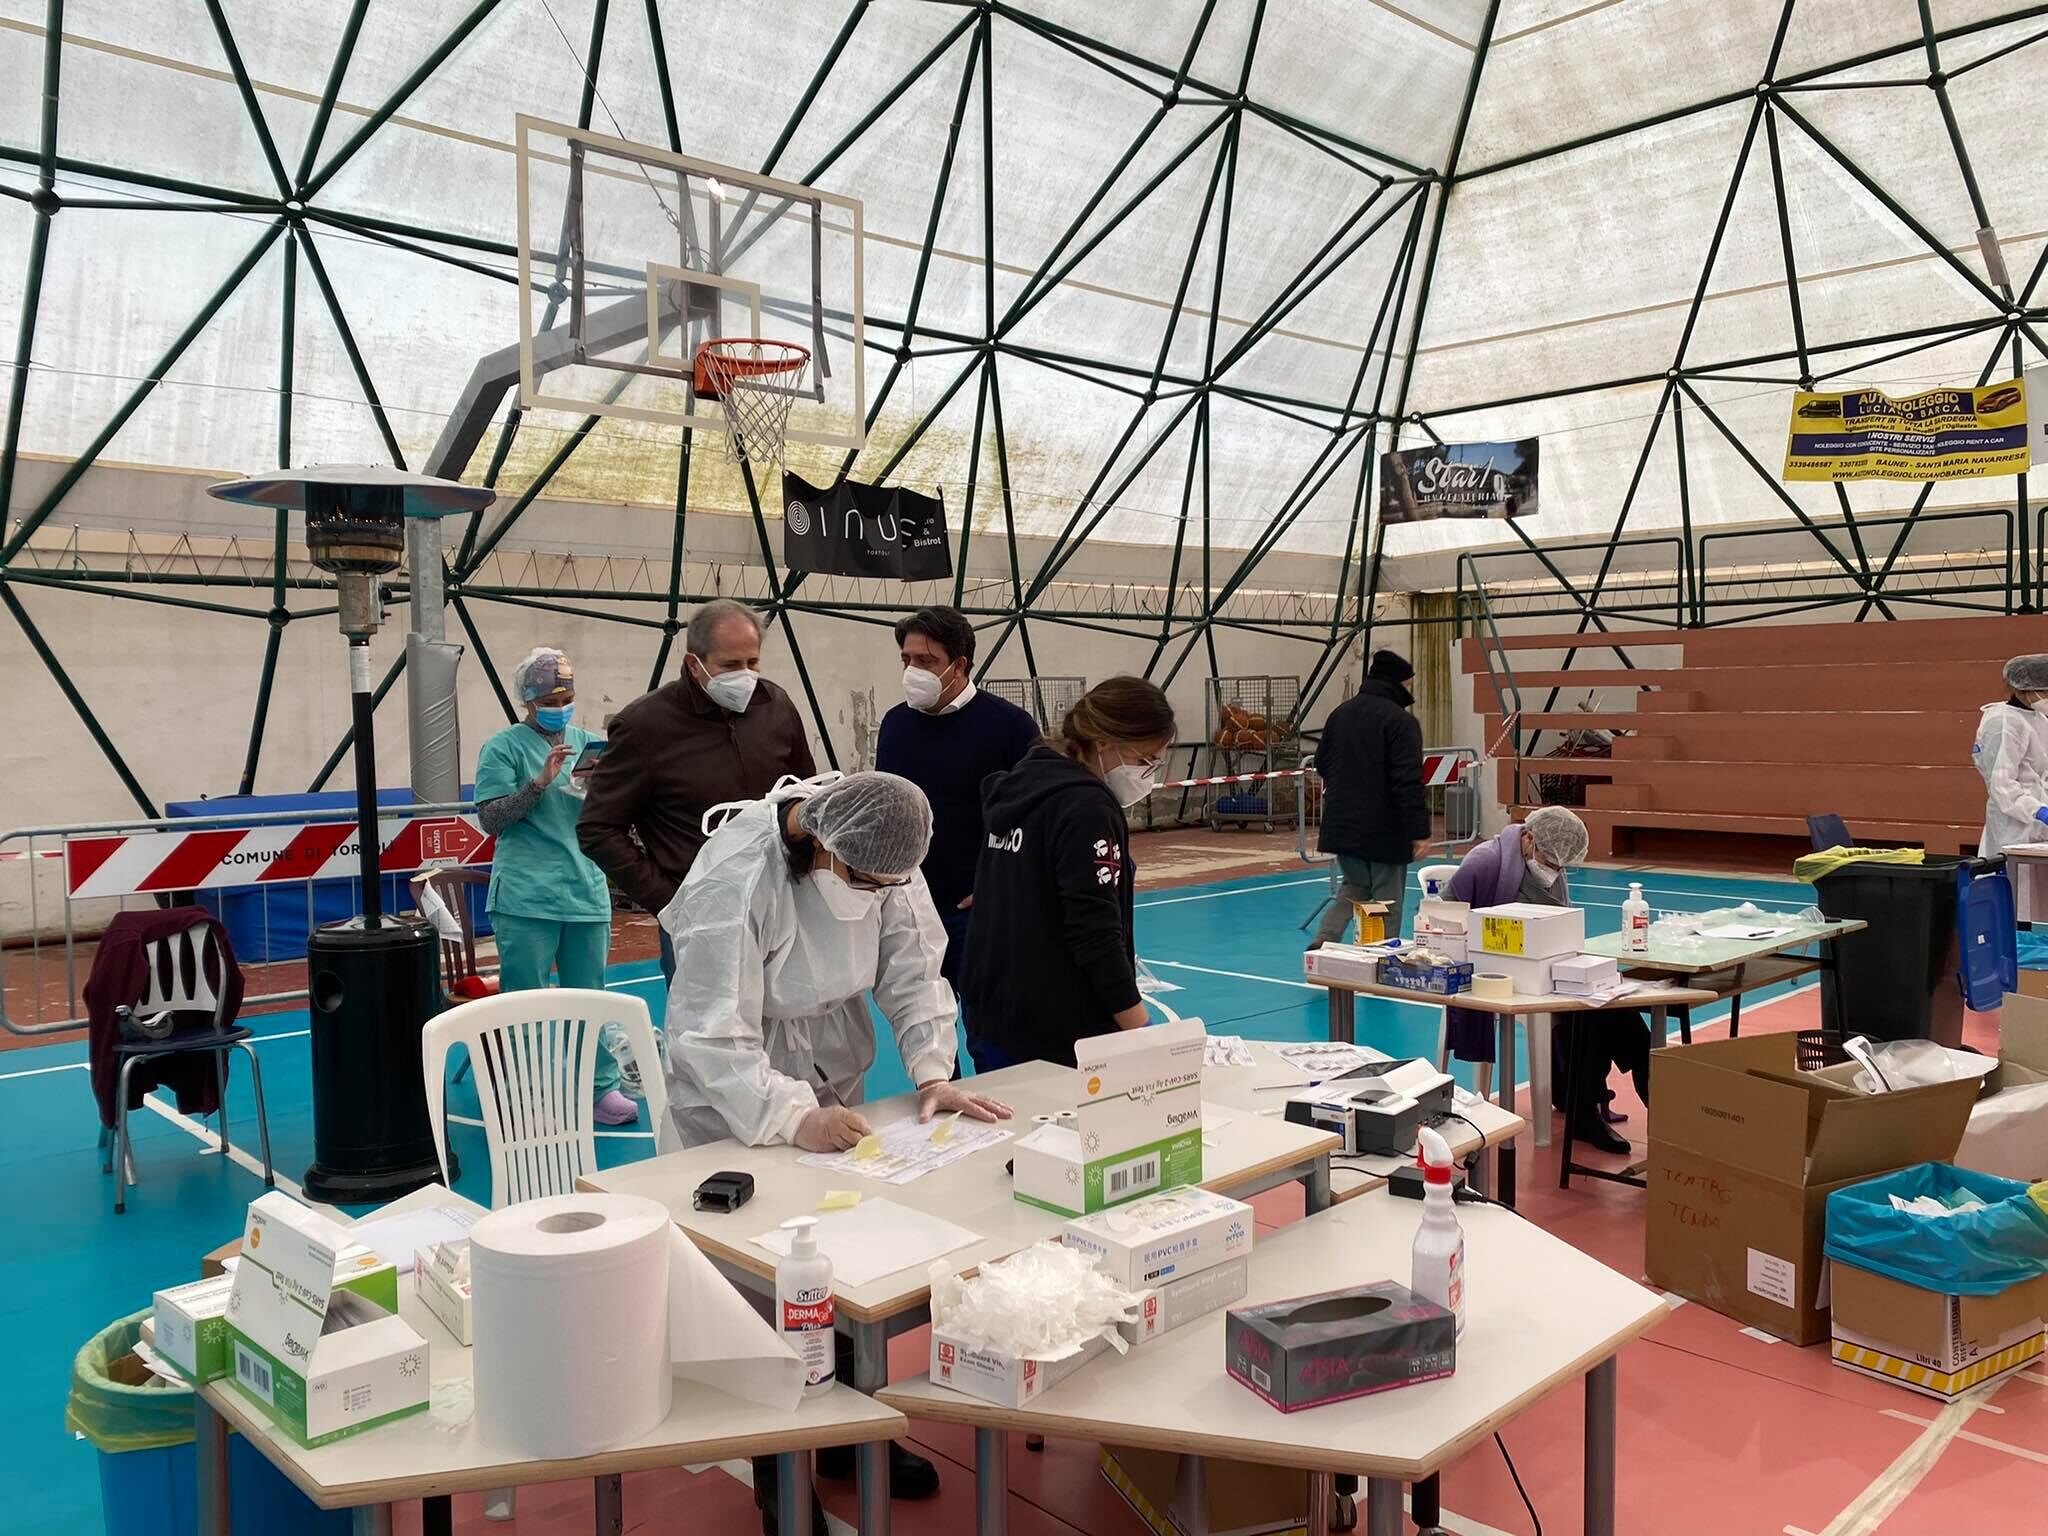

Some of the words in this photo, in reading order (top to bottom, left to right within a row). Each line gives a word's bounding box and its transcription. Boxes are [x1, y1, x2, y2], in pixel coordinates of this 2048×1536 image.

[1859, 405, 1914, 420] LUCIAO
[1920, 405, 1961, 418] BARCA
[1872, 432, 1904, 441] NOSTRI
[1966, 437, 1983, 445] RENT
[1875, 459, 1909, 468] BAUNEI
[1915, 461, 1941, 469] SANTA
[1942, 458, 1970, 468] MARIA
[1971, 451, 2027, 465] NAVARRESE
[913, 537, 942, 548] Bistrot
[221, 849, 294, 866] COMUNE
[304, 848, 321, 861] DI
[788, 1308, 819, 1320] DERMA
[1916, 1353, 1931, 1366] Litri
[1932, 1360, 1942, 1369] 40
[941, 1364, 951, 1378] M
